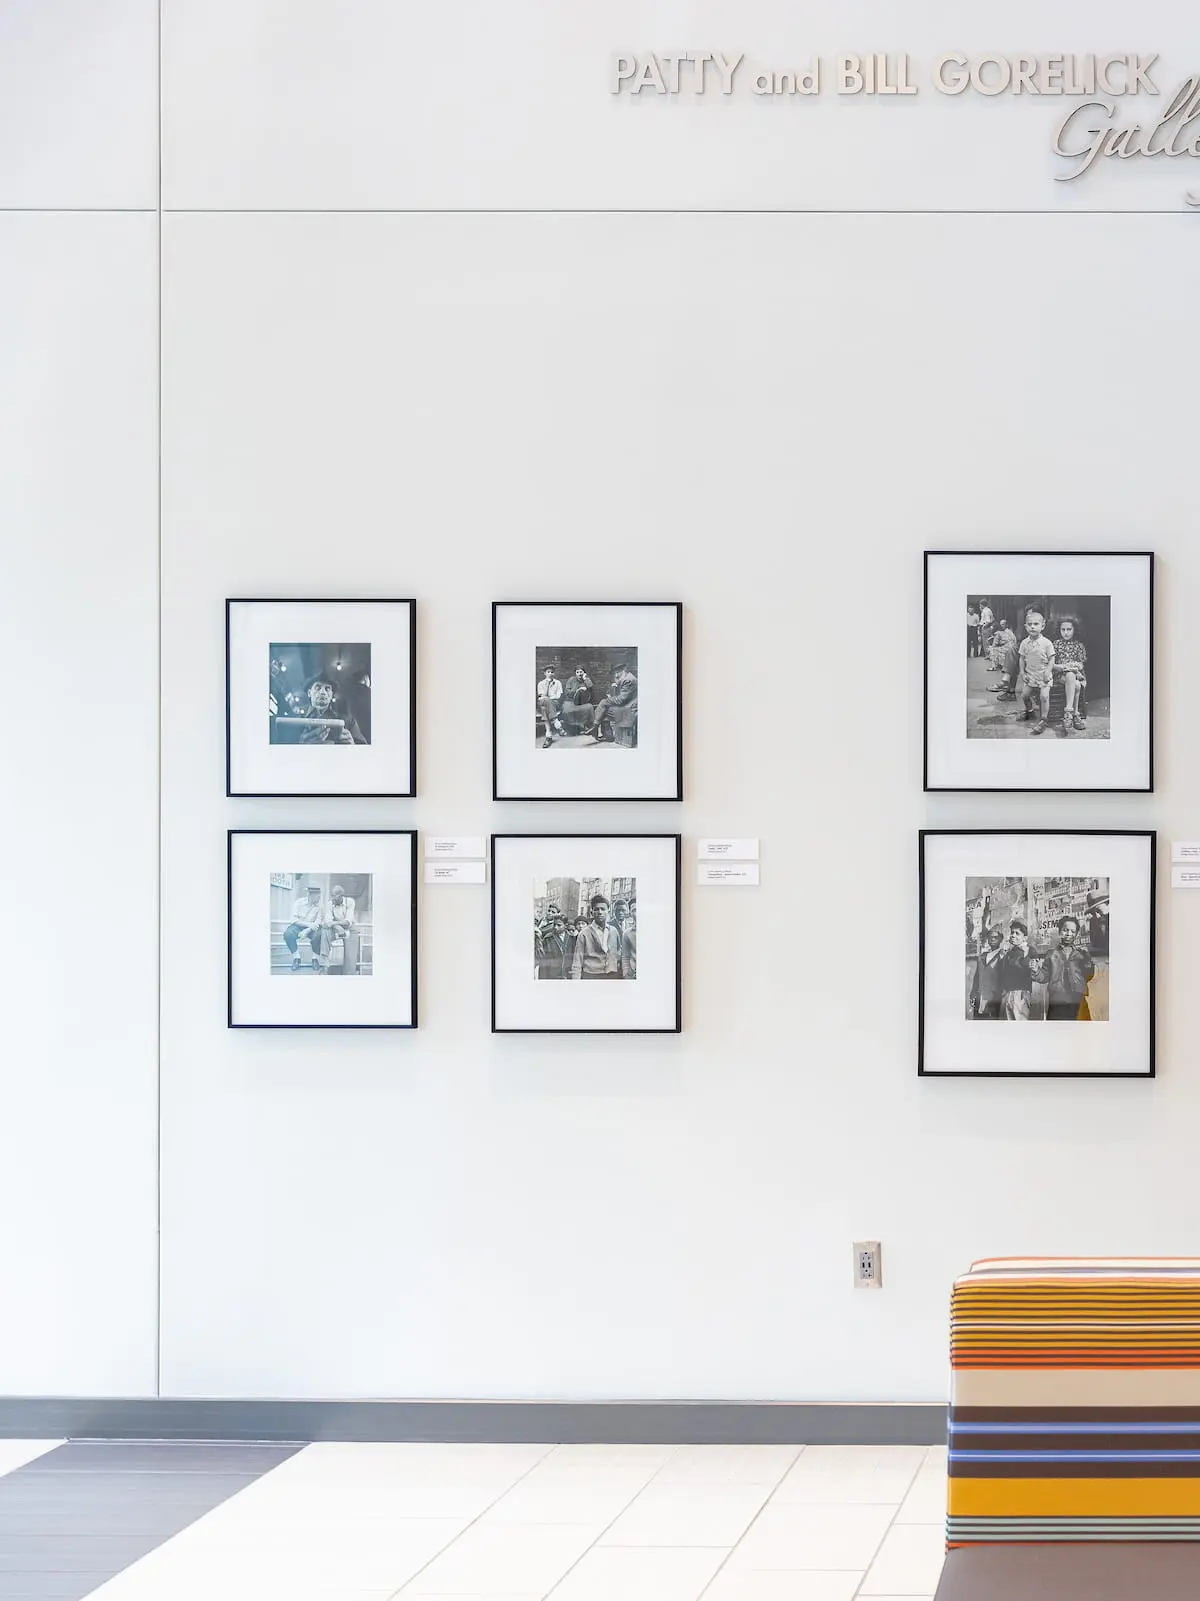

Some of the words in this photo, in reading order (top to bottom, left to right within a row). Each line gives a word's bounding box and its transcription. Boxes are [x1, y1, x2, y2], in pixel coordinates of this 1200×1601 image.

[610, 52, 745, 95] PATTY
[752, 54, 821, 96] and
[836, 52, 918, 95] BILL
[930, 52, 1161, 96] GORELICK
